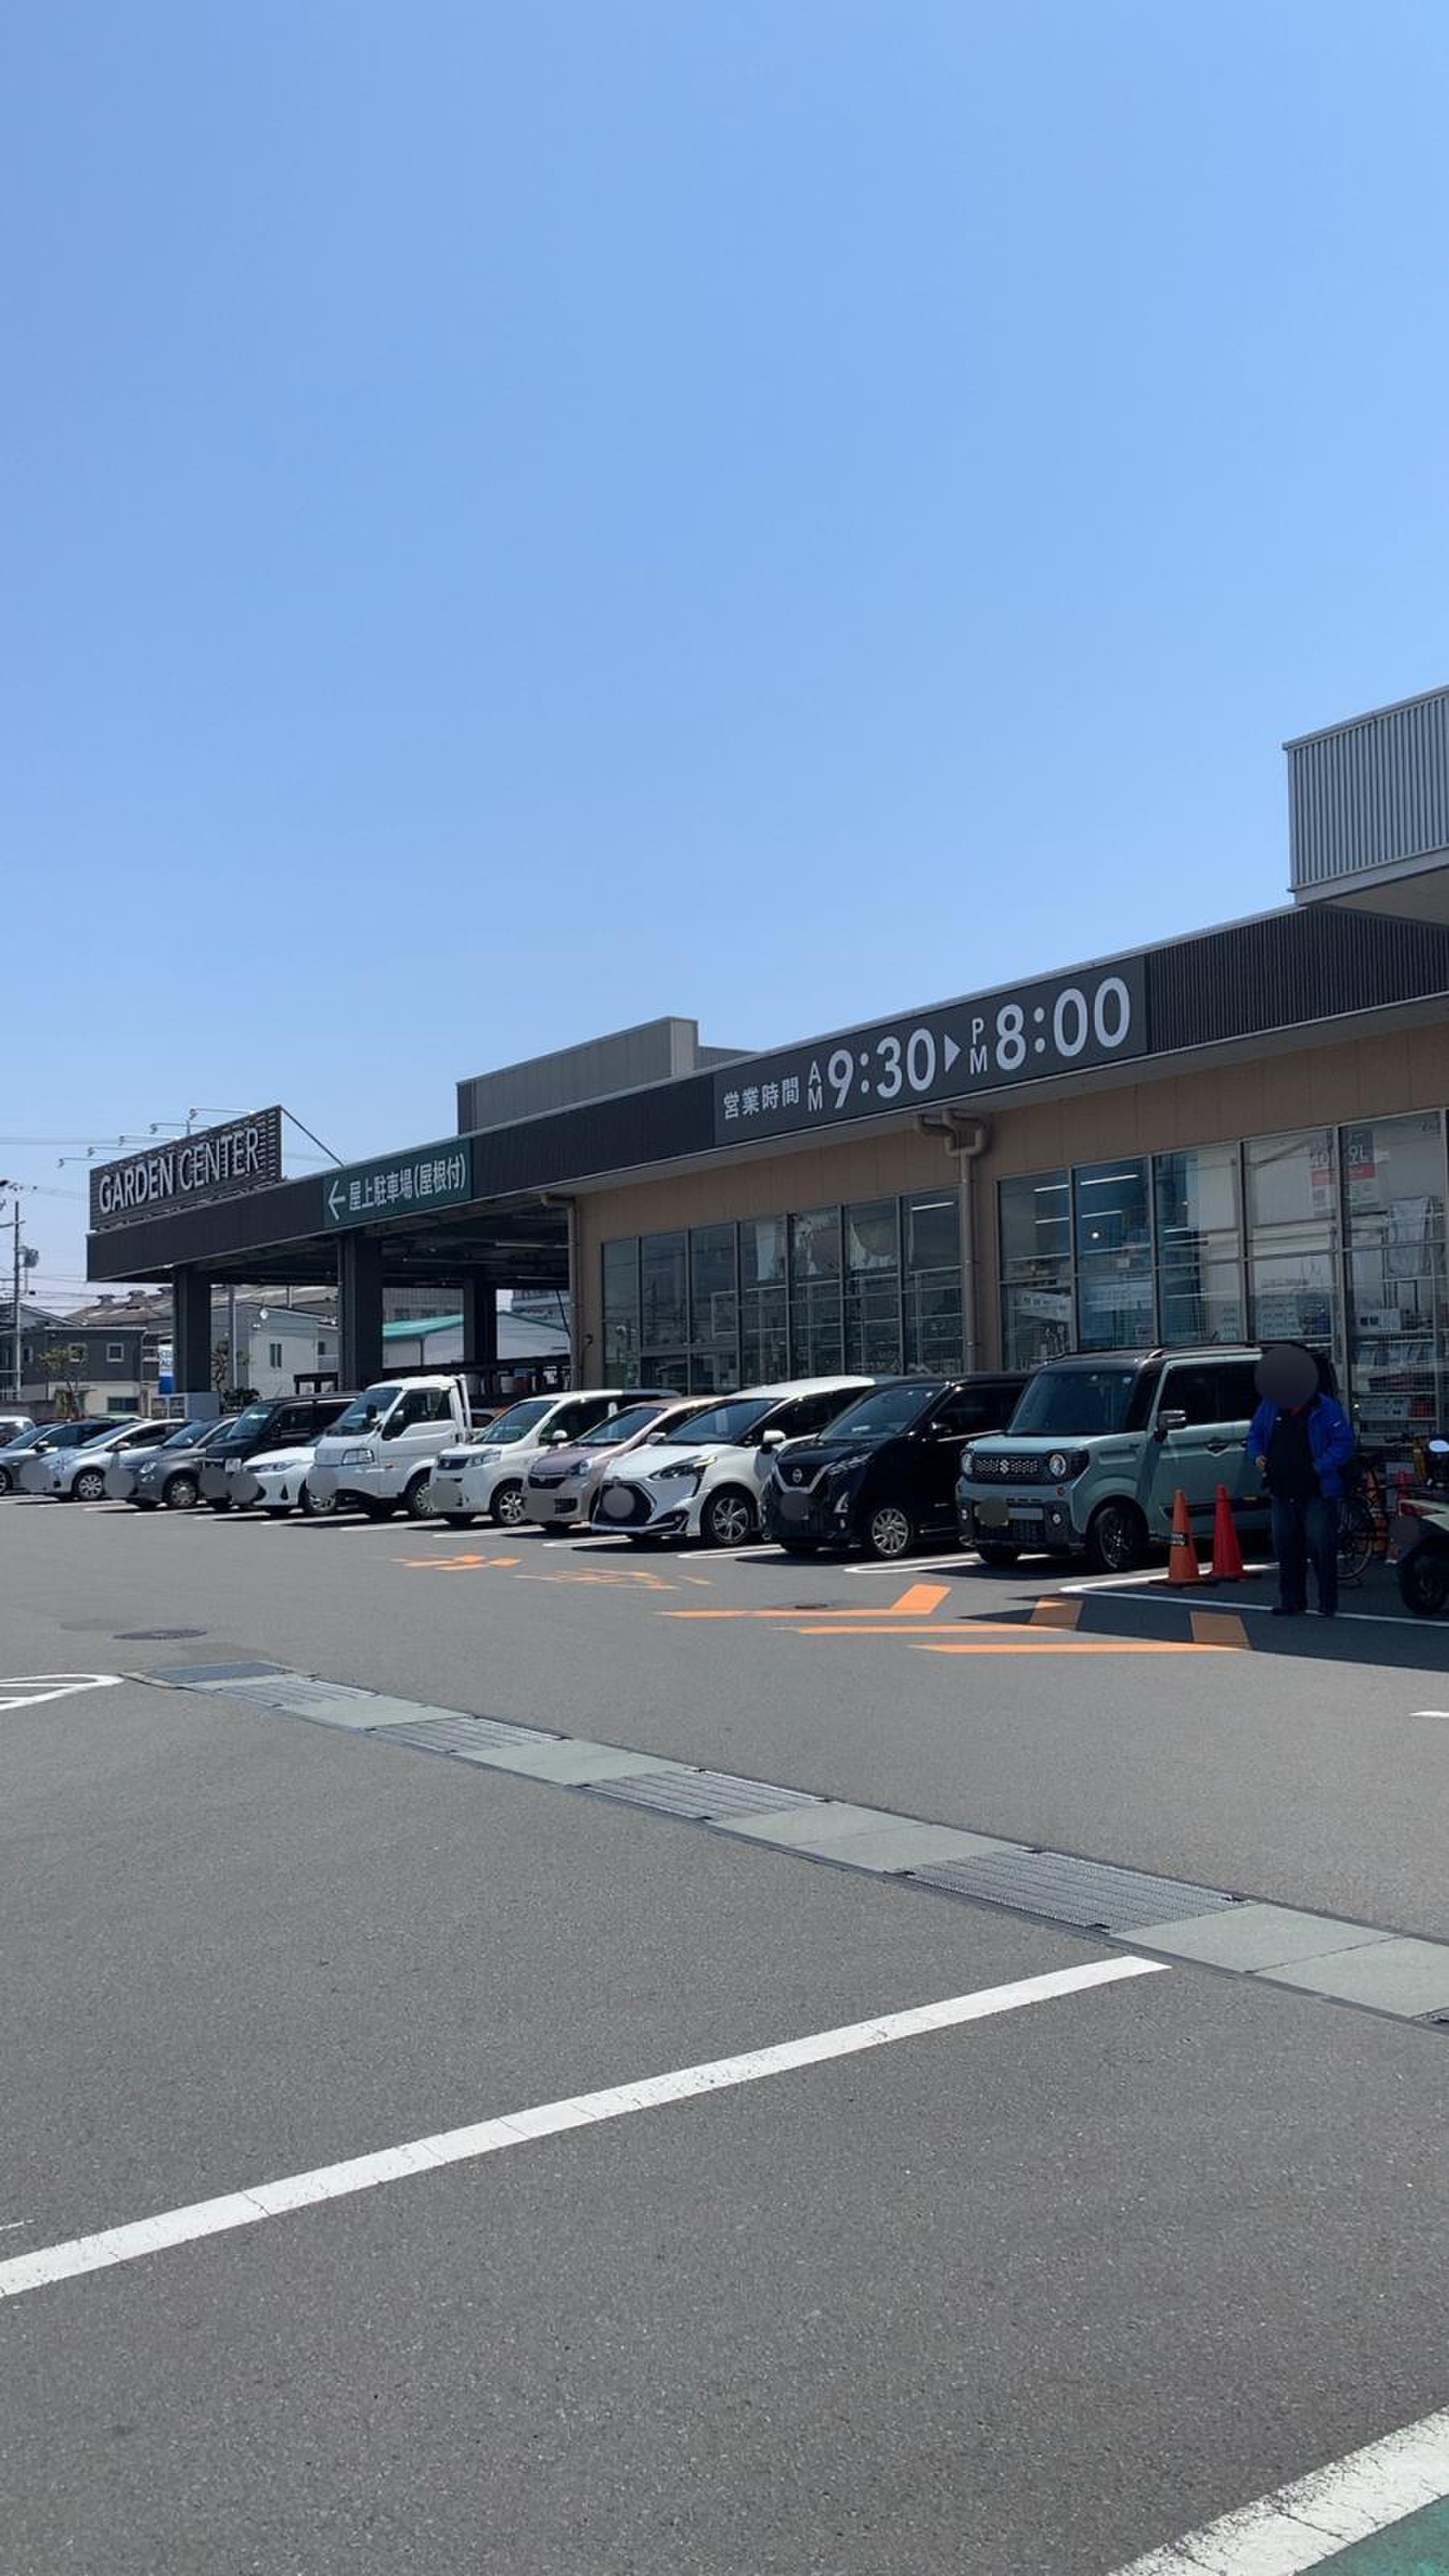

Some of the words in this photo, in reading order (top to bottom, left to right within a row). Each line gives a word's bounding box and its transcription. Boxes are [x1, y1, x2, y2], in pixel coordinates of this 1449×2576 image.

[723, 1076, 799, 1120] 営業時間
[828, 1028, 936, 1108] 9:30
[996, 976, 1131, 1071] 8:00
[98, 1152, 175, 1214] GARDEN
[180, 1127, 259, 1191] CENTER
